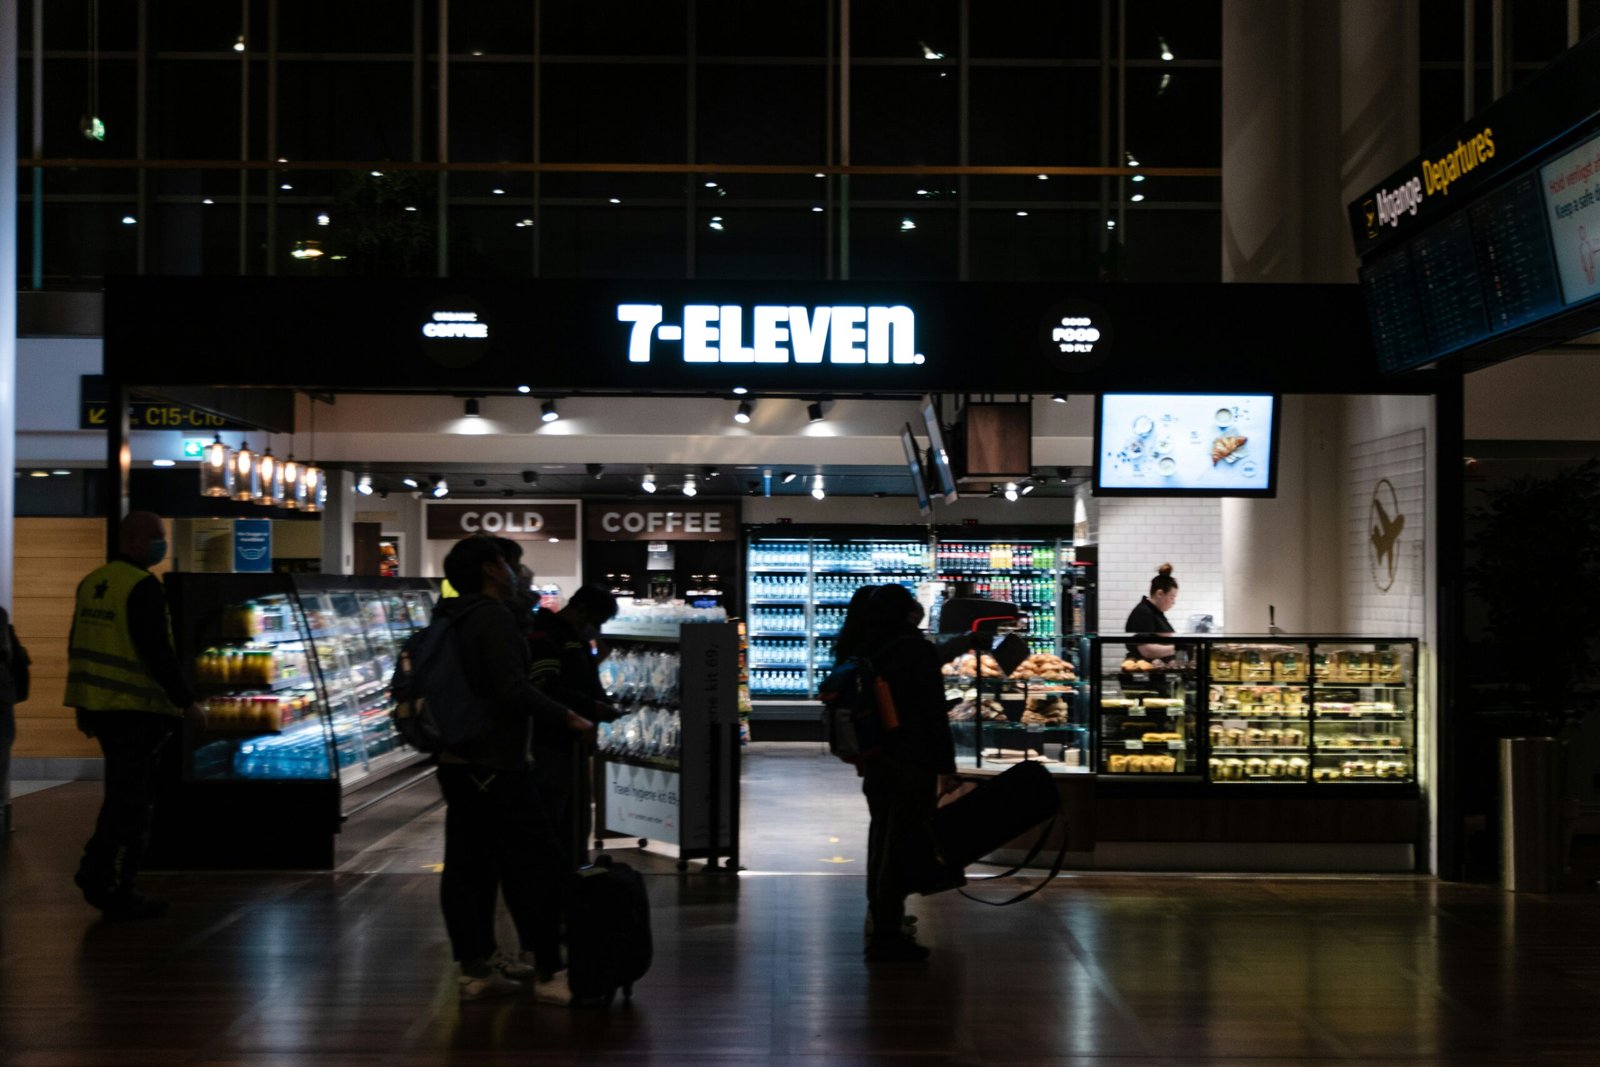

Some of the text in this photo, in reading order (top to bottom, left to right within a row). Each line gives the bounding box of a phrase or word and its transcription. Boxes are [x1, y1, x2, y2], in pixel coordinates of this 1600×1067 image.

[1422, 127, 1496, 197] Departures
[422, 322, 489, 338] COFFEE
[1052, 327, 1101, 342] FOOD
[1059, 343, 1094, 353] TO FLY
[459, 511, 545, 533] COLD
[601, 511, 721, 533] COFFEE
